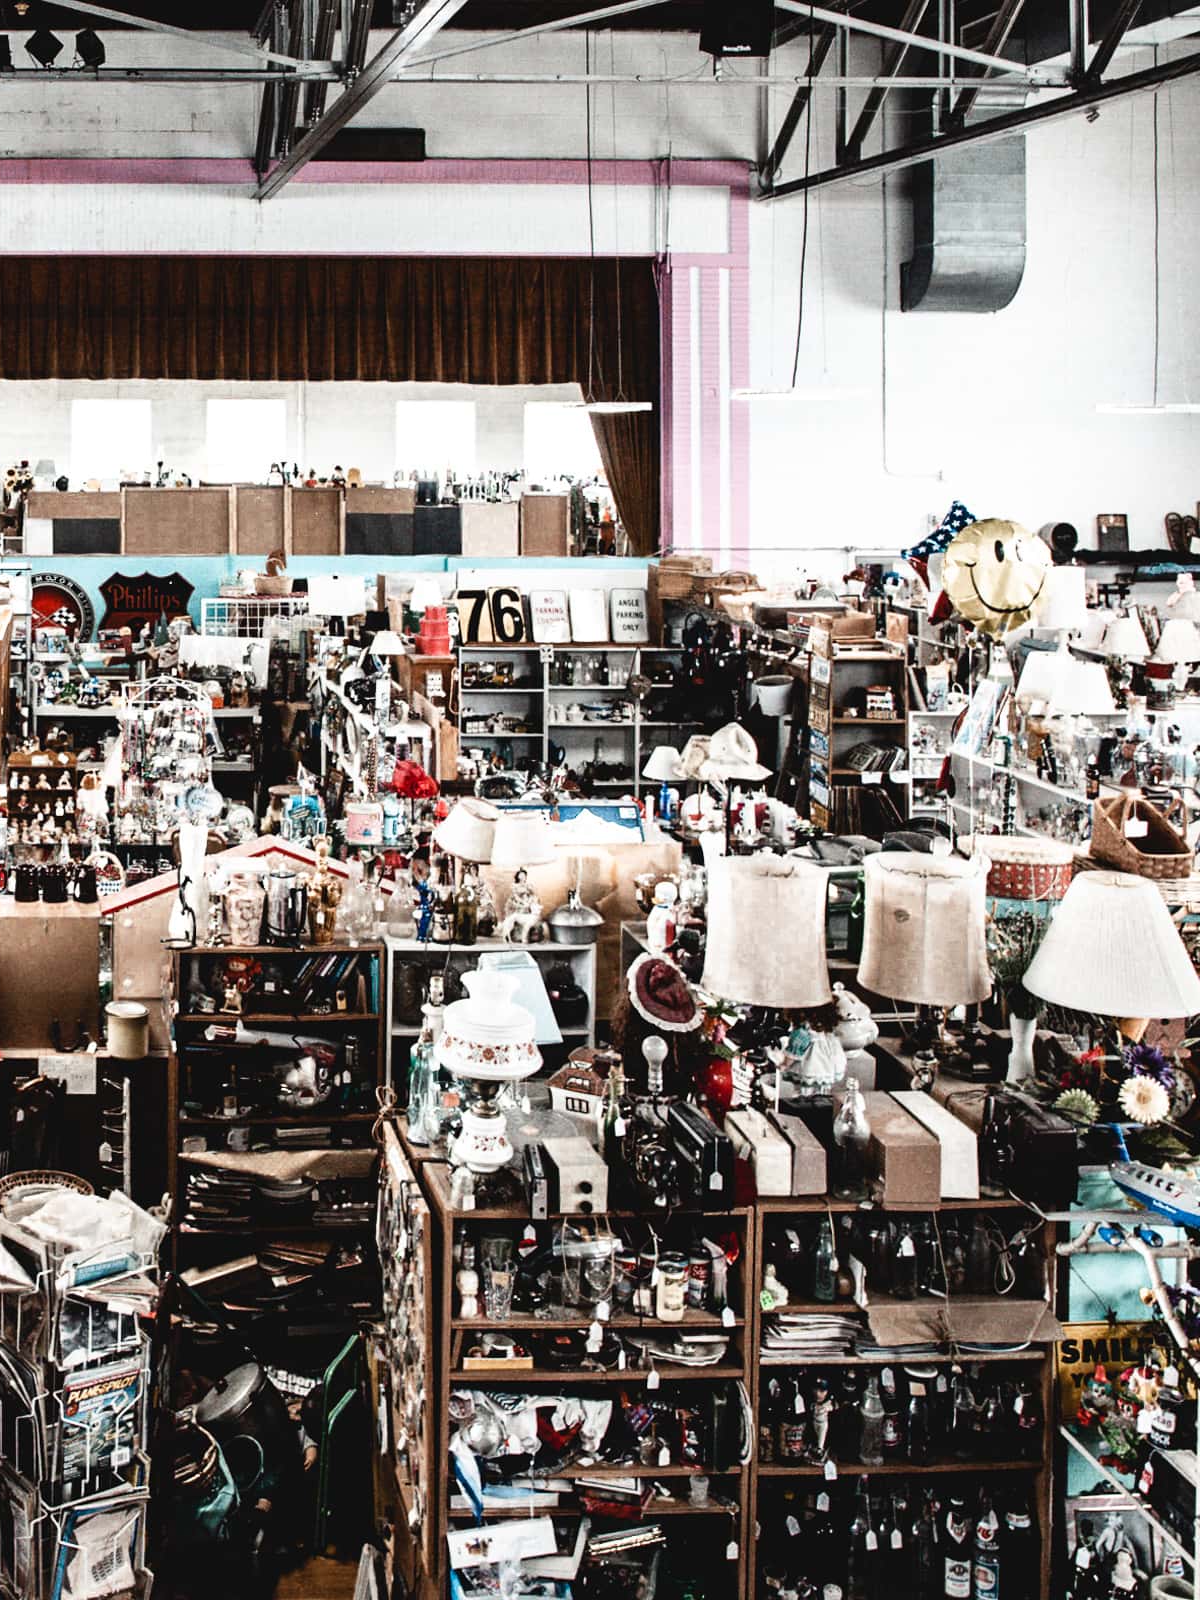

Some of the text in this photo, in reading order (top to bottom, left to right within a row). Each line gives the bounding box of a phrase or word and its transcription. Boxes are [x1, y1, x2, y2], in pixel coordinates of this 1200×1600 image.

[35, 575, 74, 591] MOTOR
[108, 583, 181, 612] Phillips
[618, 599, 640, 608] ANGLE
[457, 589, 523, 642] 76
[616, 610, 645, 619] PARKING
[622, 623, 640, 632] ONLY
